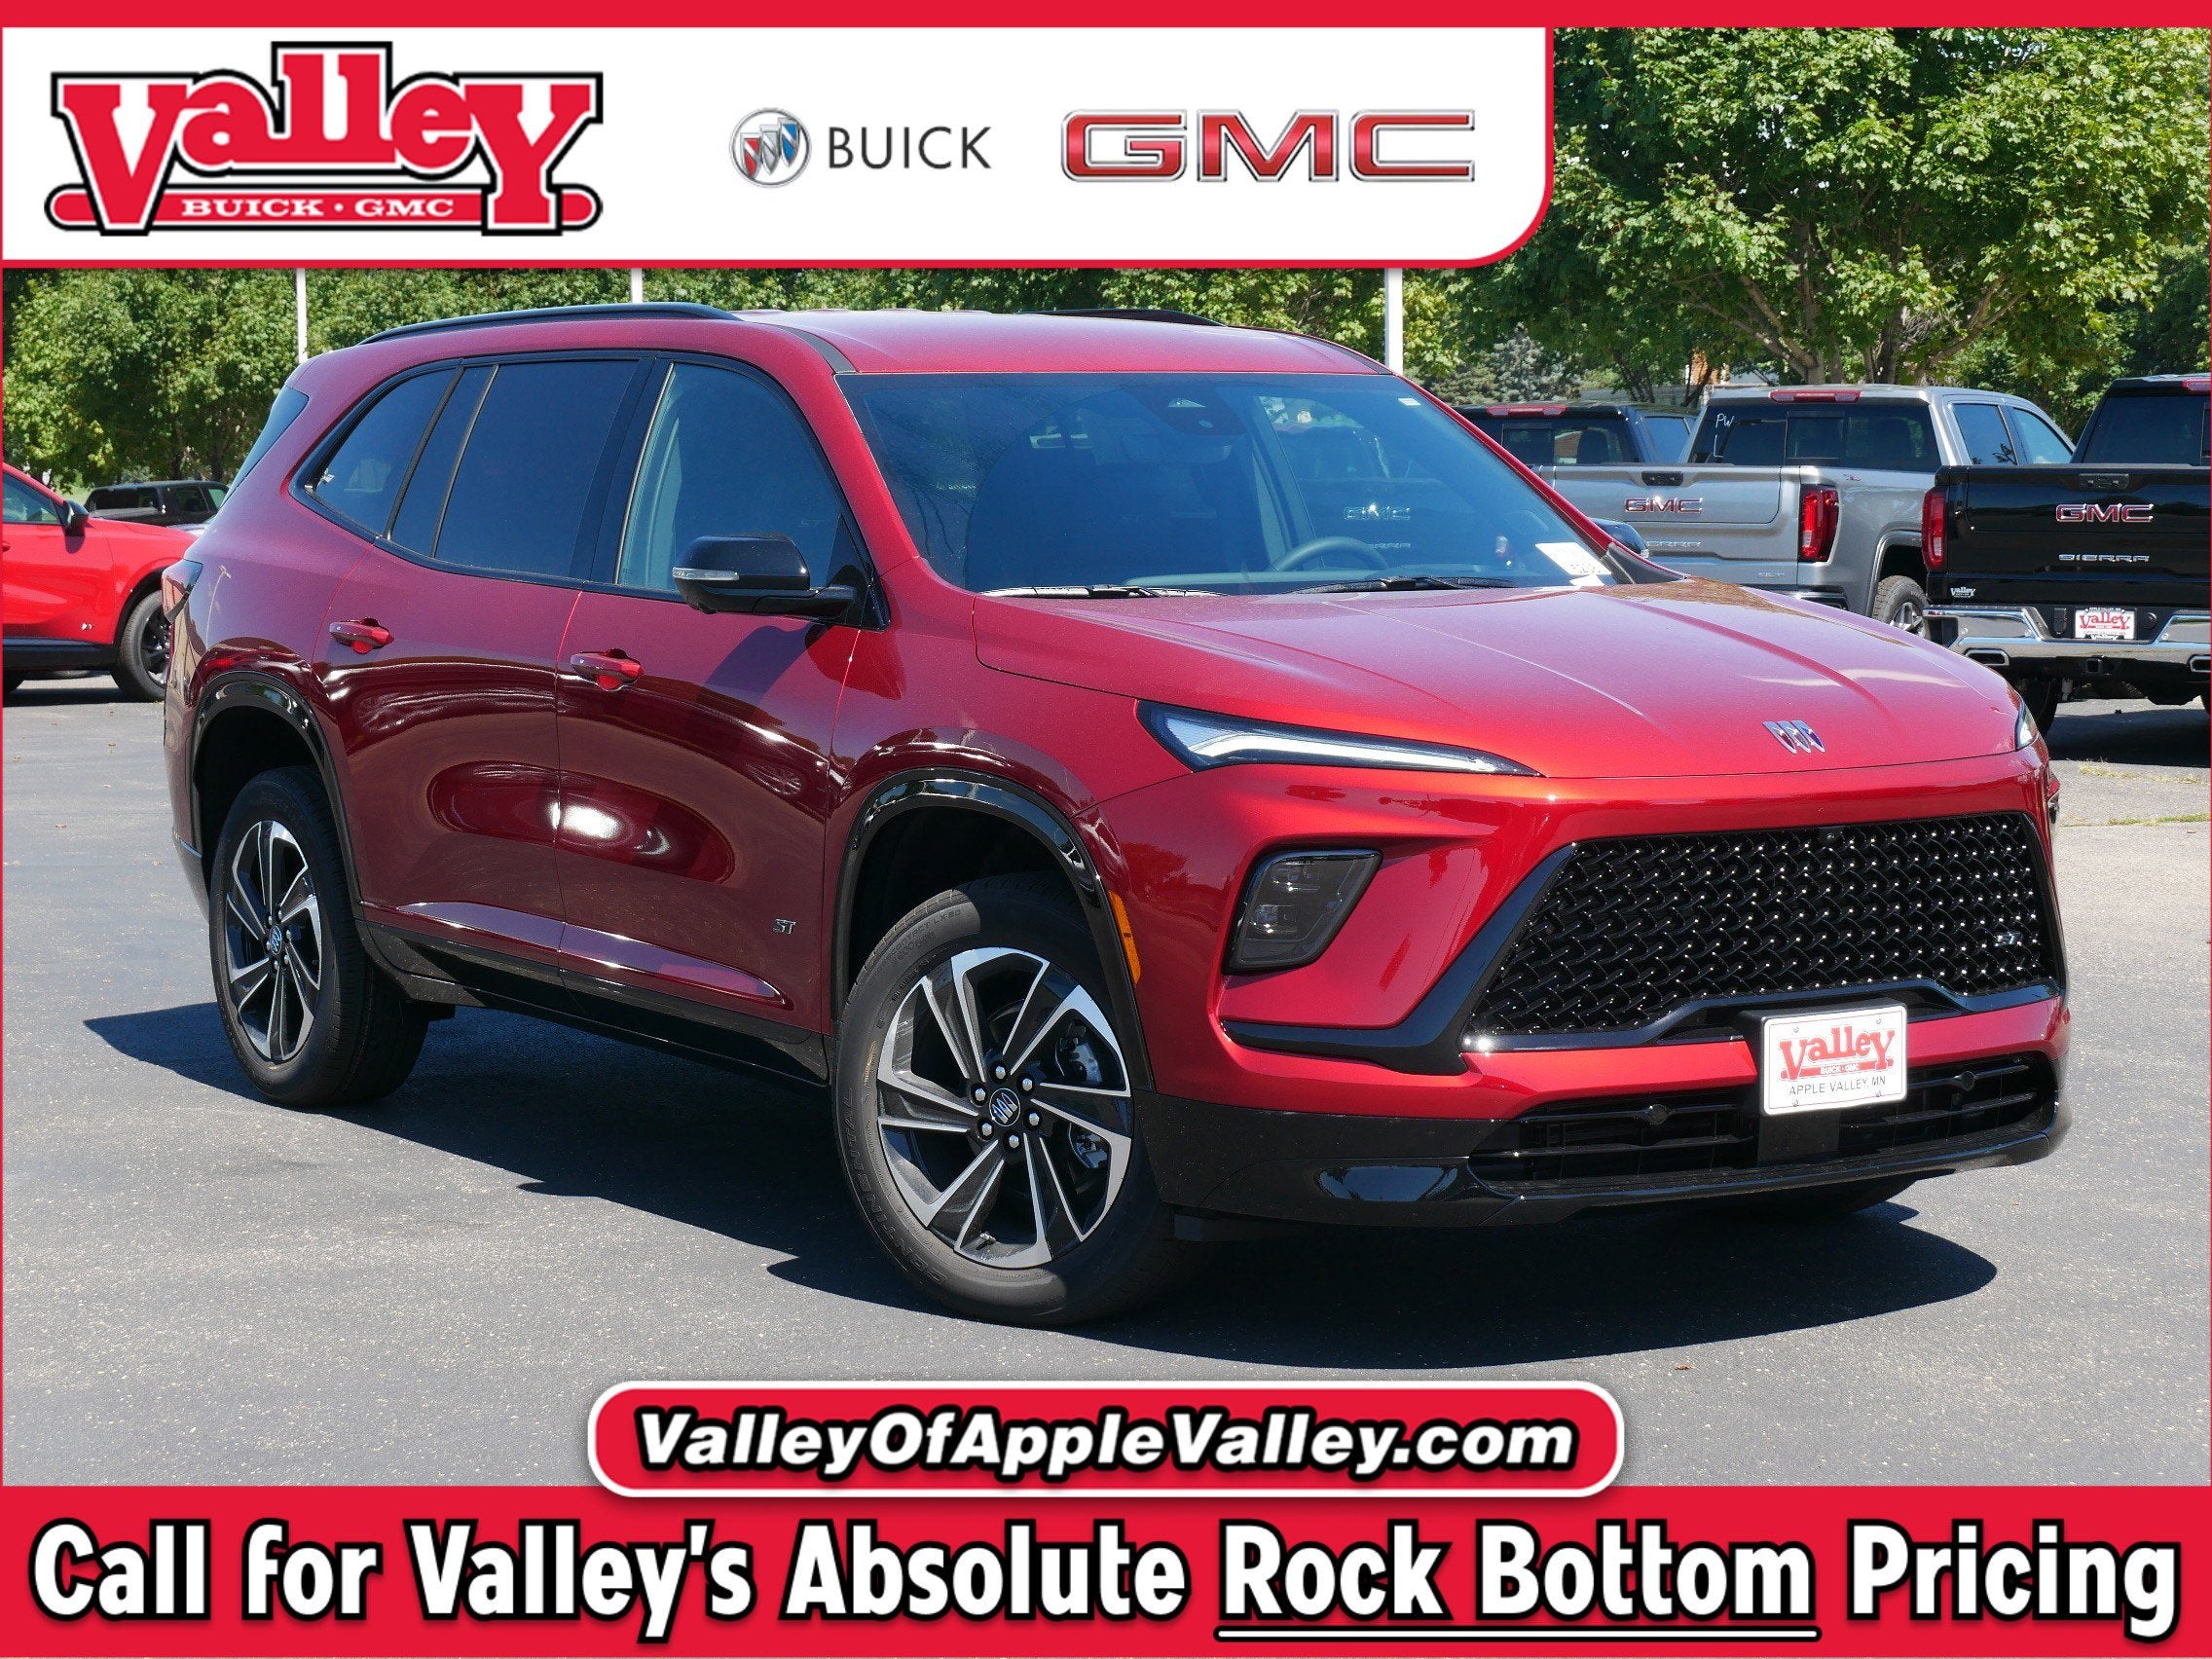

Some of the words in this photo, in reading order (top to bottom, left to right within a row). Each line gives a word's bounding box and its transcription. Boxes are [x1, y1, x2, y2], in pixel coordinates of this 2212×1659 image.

[1624, 498, 1704, 513] GMC
[2056, 503, 2155, 523] GMC
[2058, 553, 2151, 563] SIERRA
[2080, 611, 2131, 630] Valley
[772, 918, 796, 935] ST
[1779, 1026, 1896, 1080] Valley
[1788, 1083, 1825, 1096] APPLE
[1871, 1075, 1886, 1087] MN
